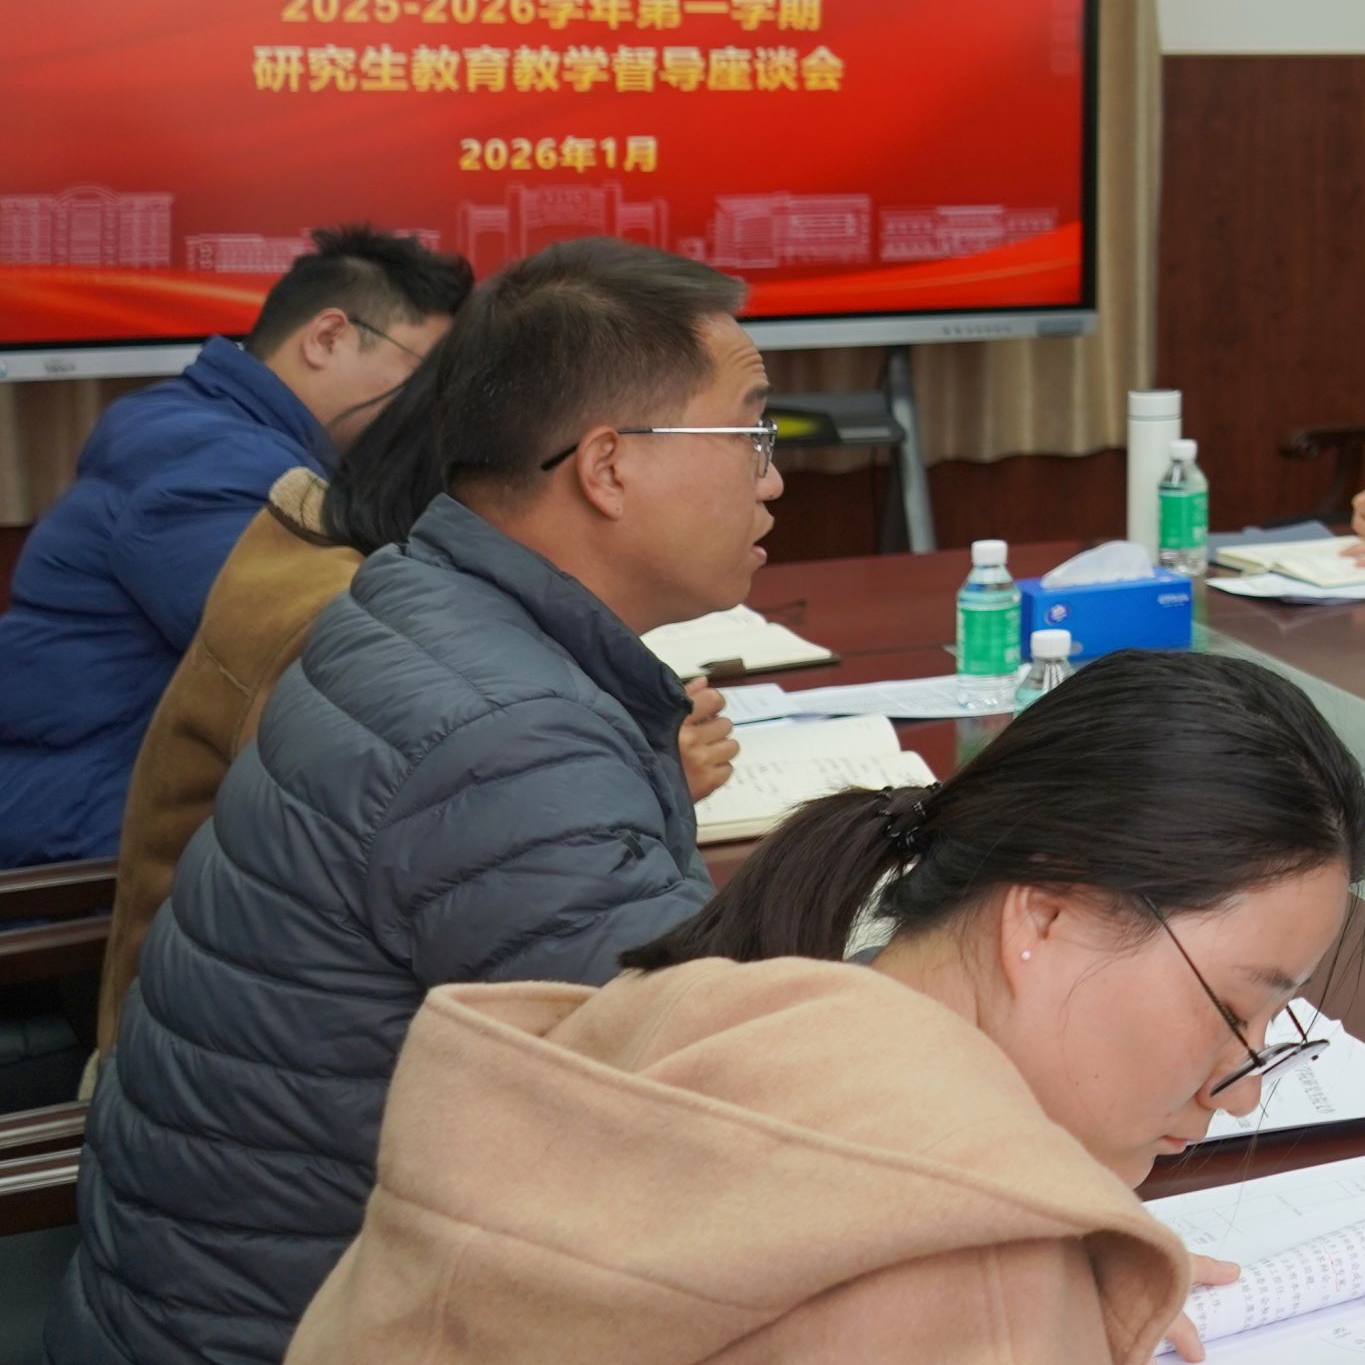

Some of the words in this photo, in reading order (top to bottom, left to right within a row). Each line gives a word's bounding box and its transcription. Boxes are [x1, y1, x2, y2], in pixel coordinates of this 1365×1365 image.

[252, 42, 845, 92] 研究生教育教学督导座谈会
[458, 135, 659, 174] 2026年1月
